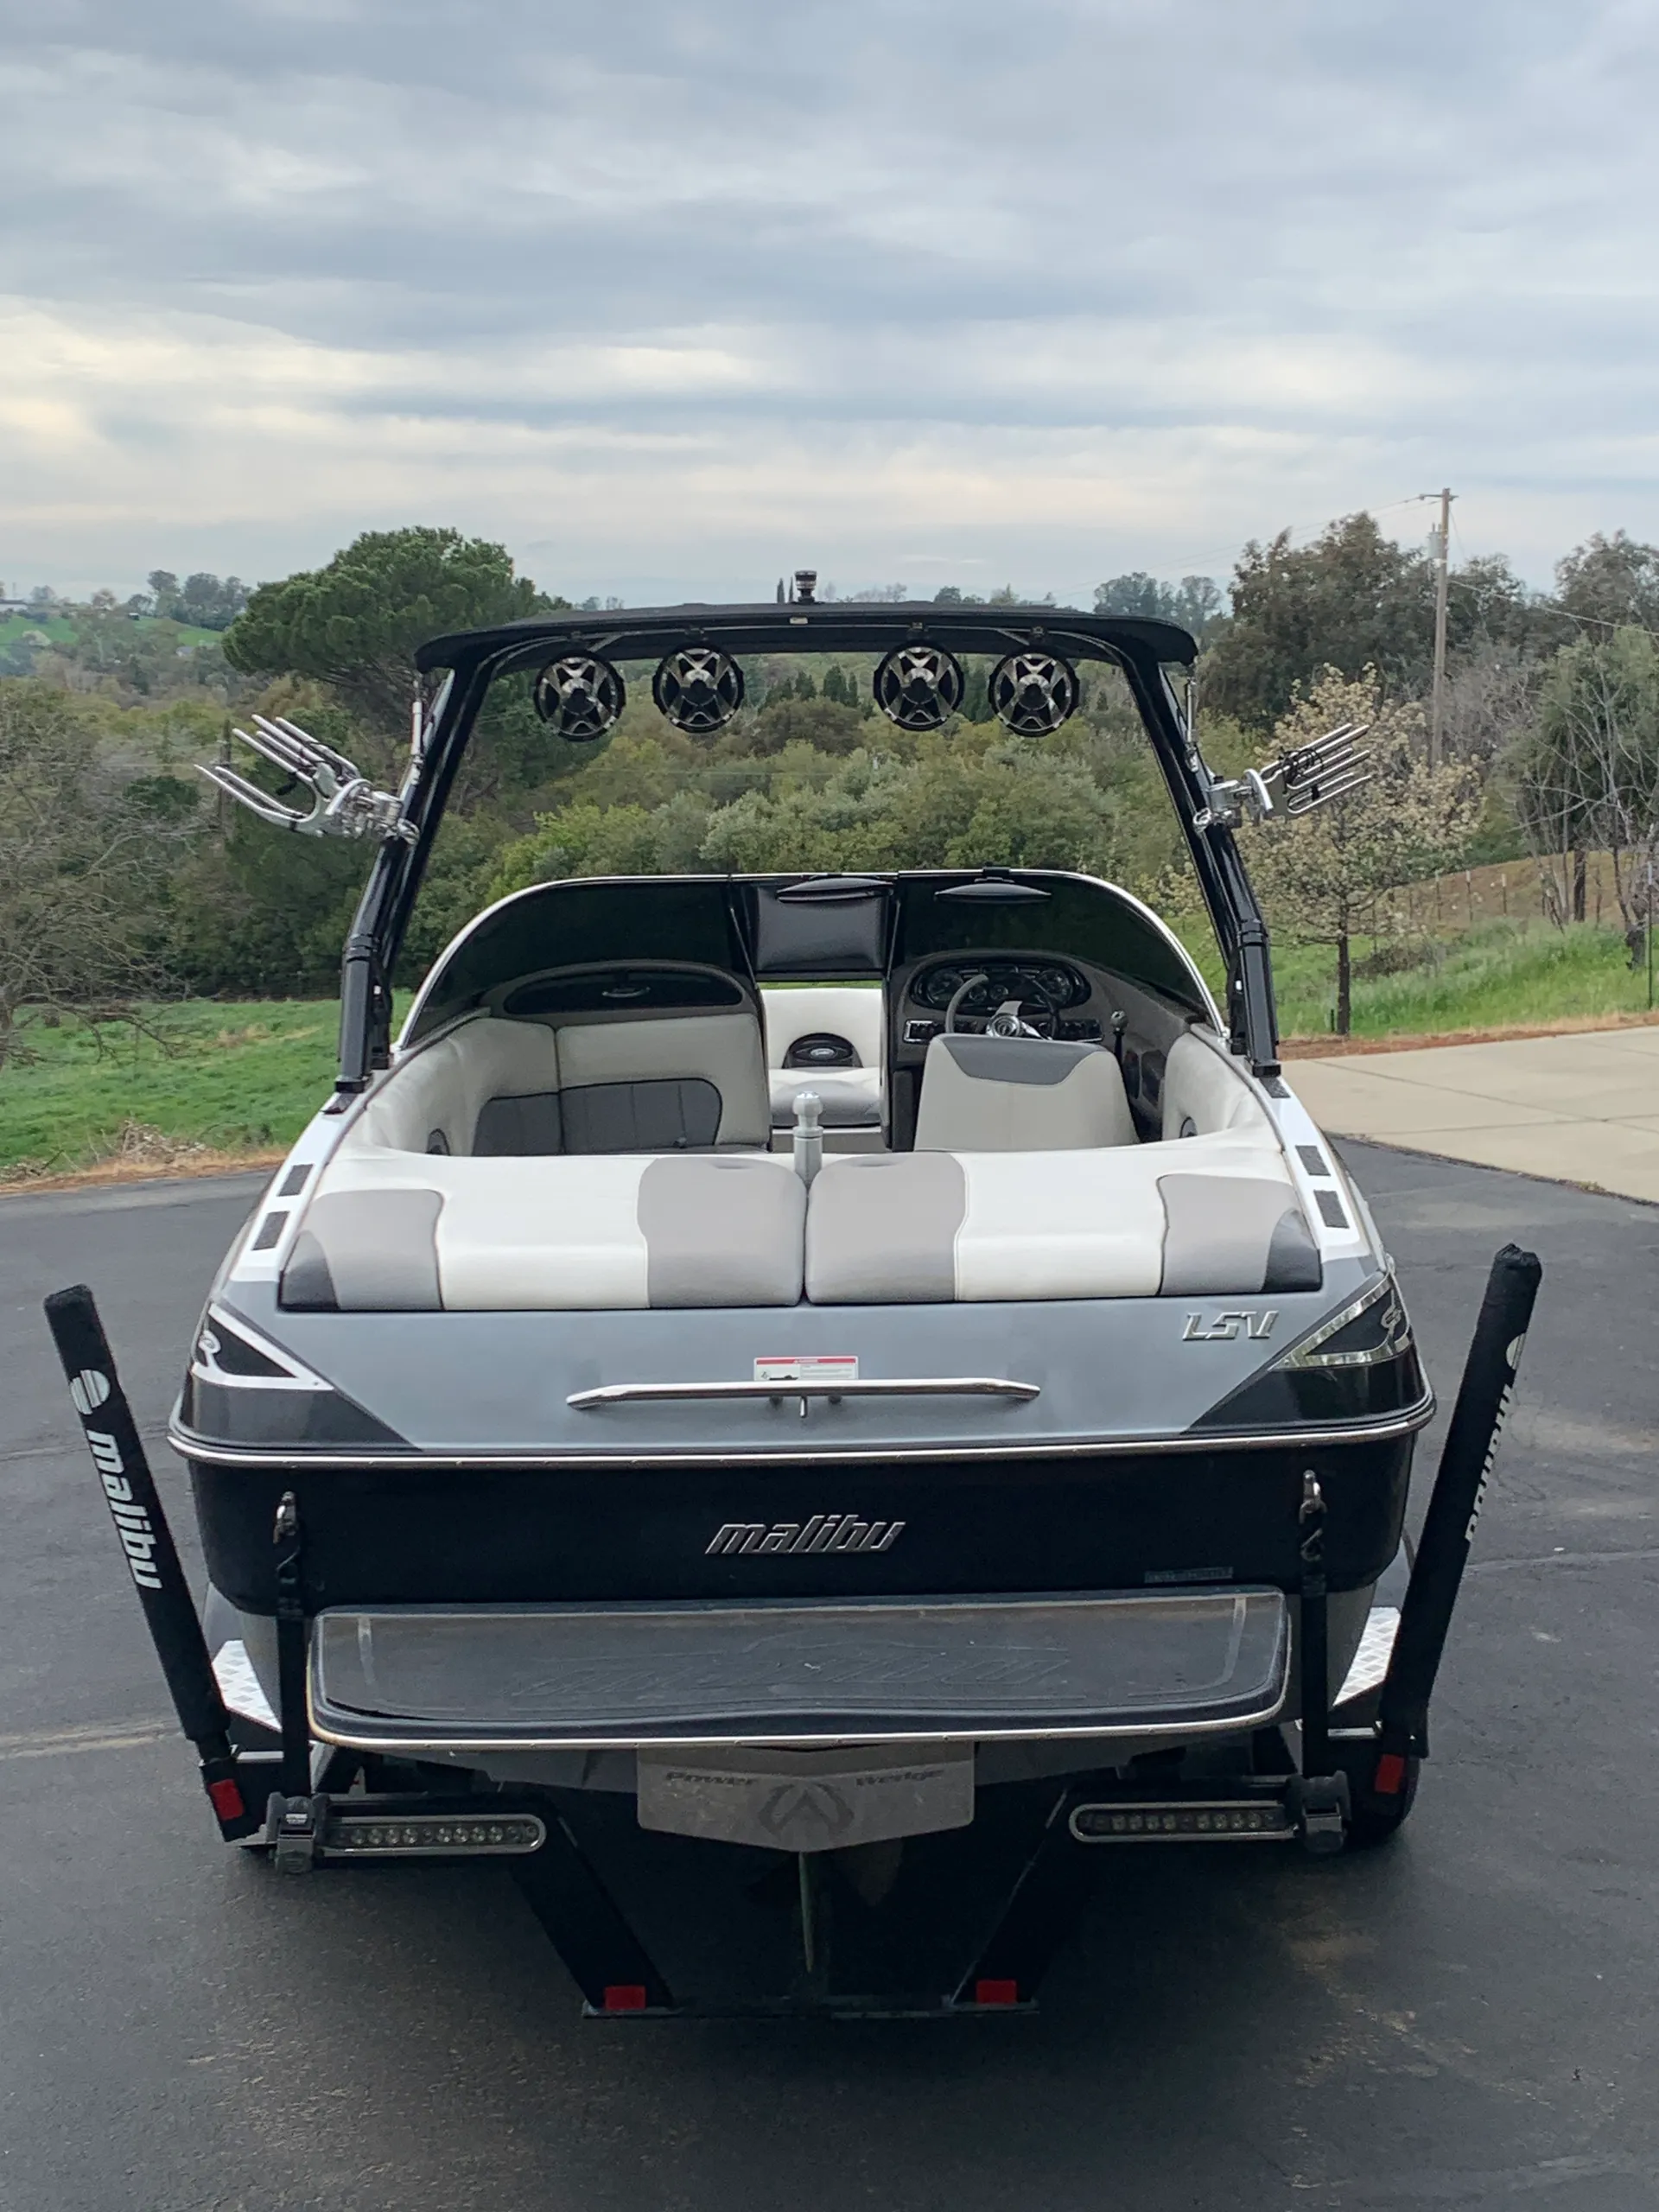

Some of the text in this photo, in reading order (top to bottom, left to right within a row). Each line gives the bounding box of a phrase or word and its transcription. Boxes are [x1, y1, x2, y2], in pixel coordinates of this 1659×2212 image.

[1181, 1309, 1279, 1341] LSV
[86, 1429, 163, 1589] malibu
[704, 1514, 906, 1554] malibu
